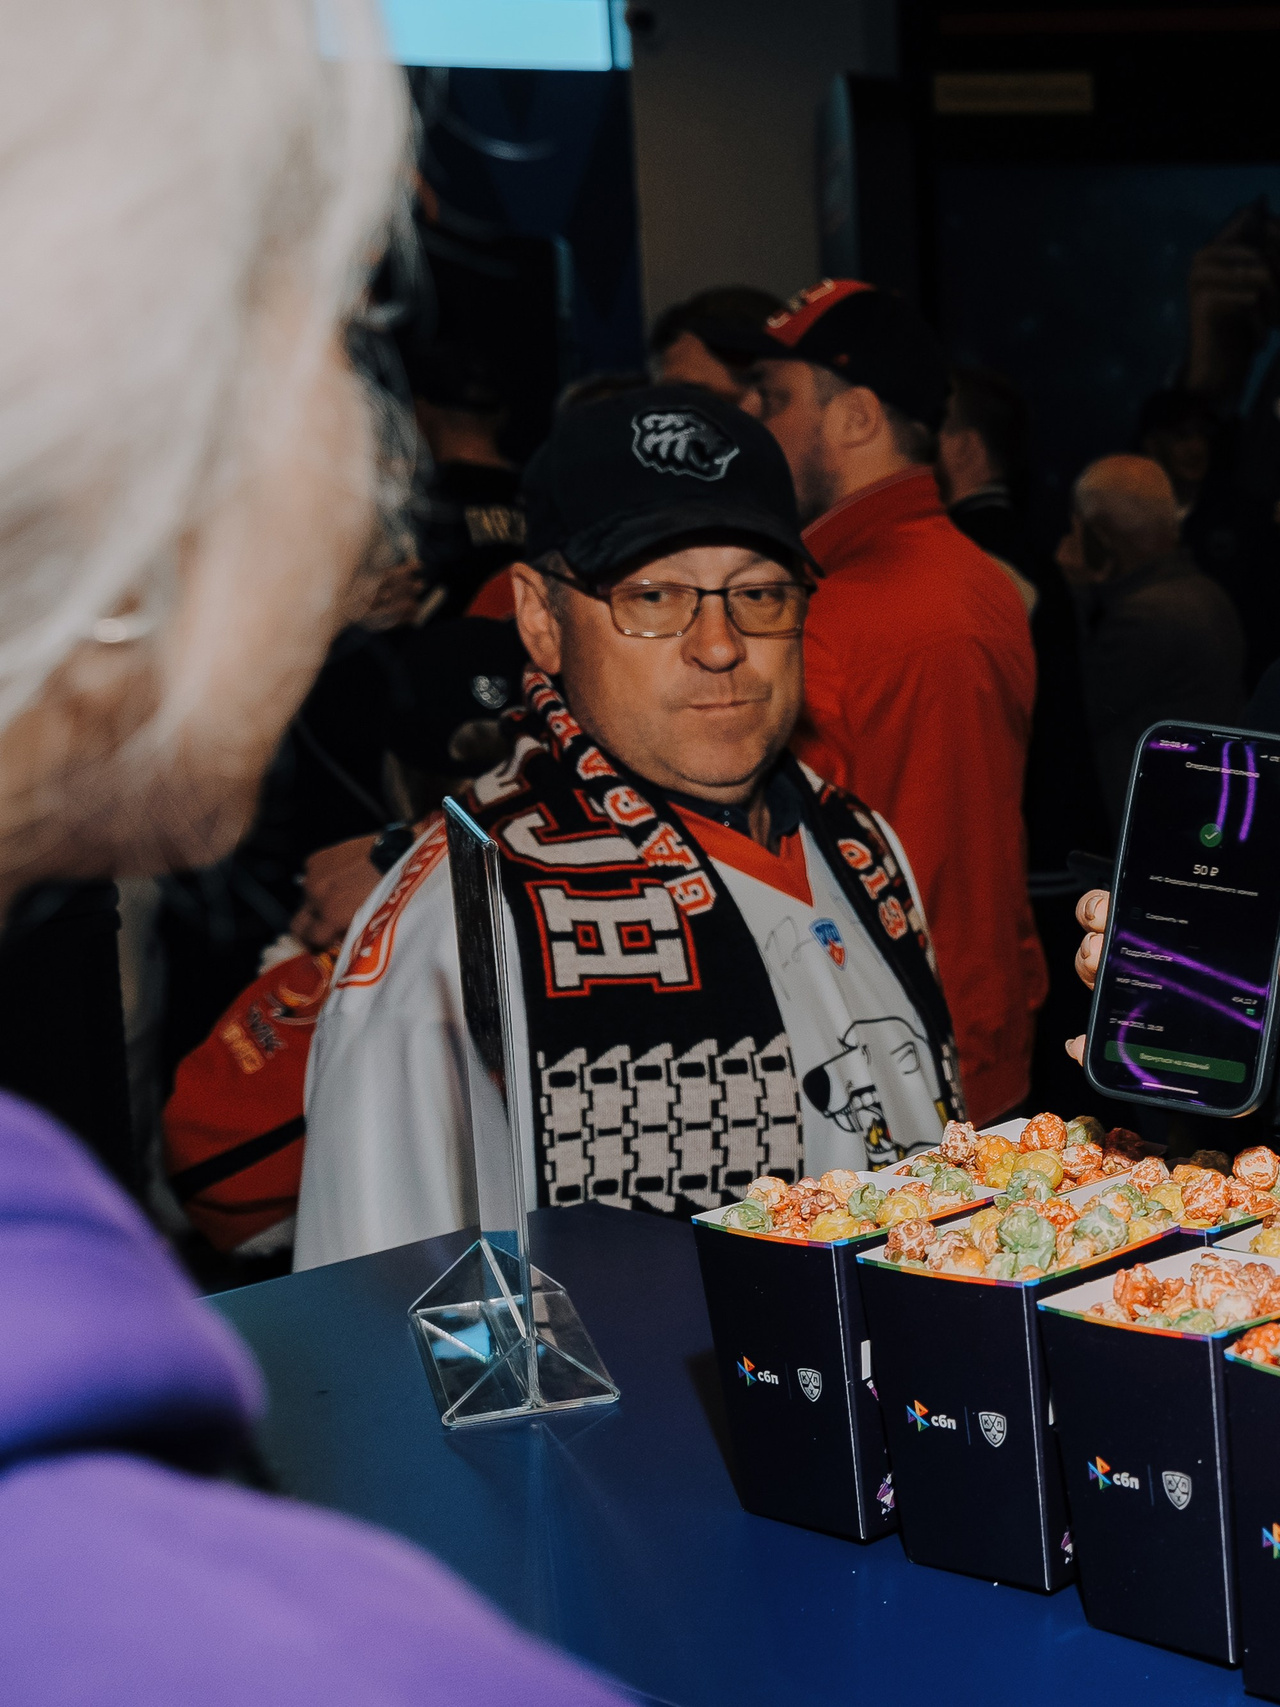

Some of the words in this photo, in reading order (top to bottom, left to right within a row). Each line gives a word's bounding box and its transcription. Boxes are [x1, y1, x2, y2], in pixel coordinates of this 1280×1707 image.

[1192, 863, 1209, 877] 50
[757, 1370, 779, 1385] сбп
[930, 1414, 957, 1430] сбп
[1112, 1471, 1140, 1490] сбп
